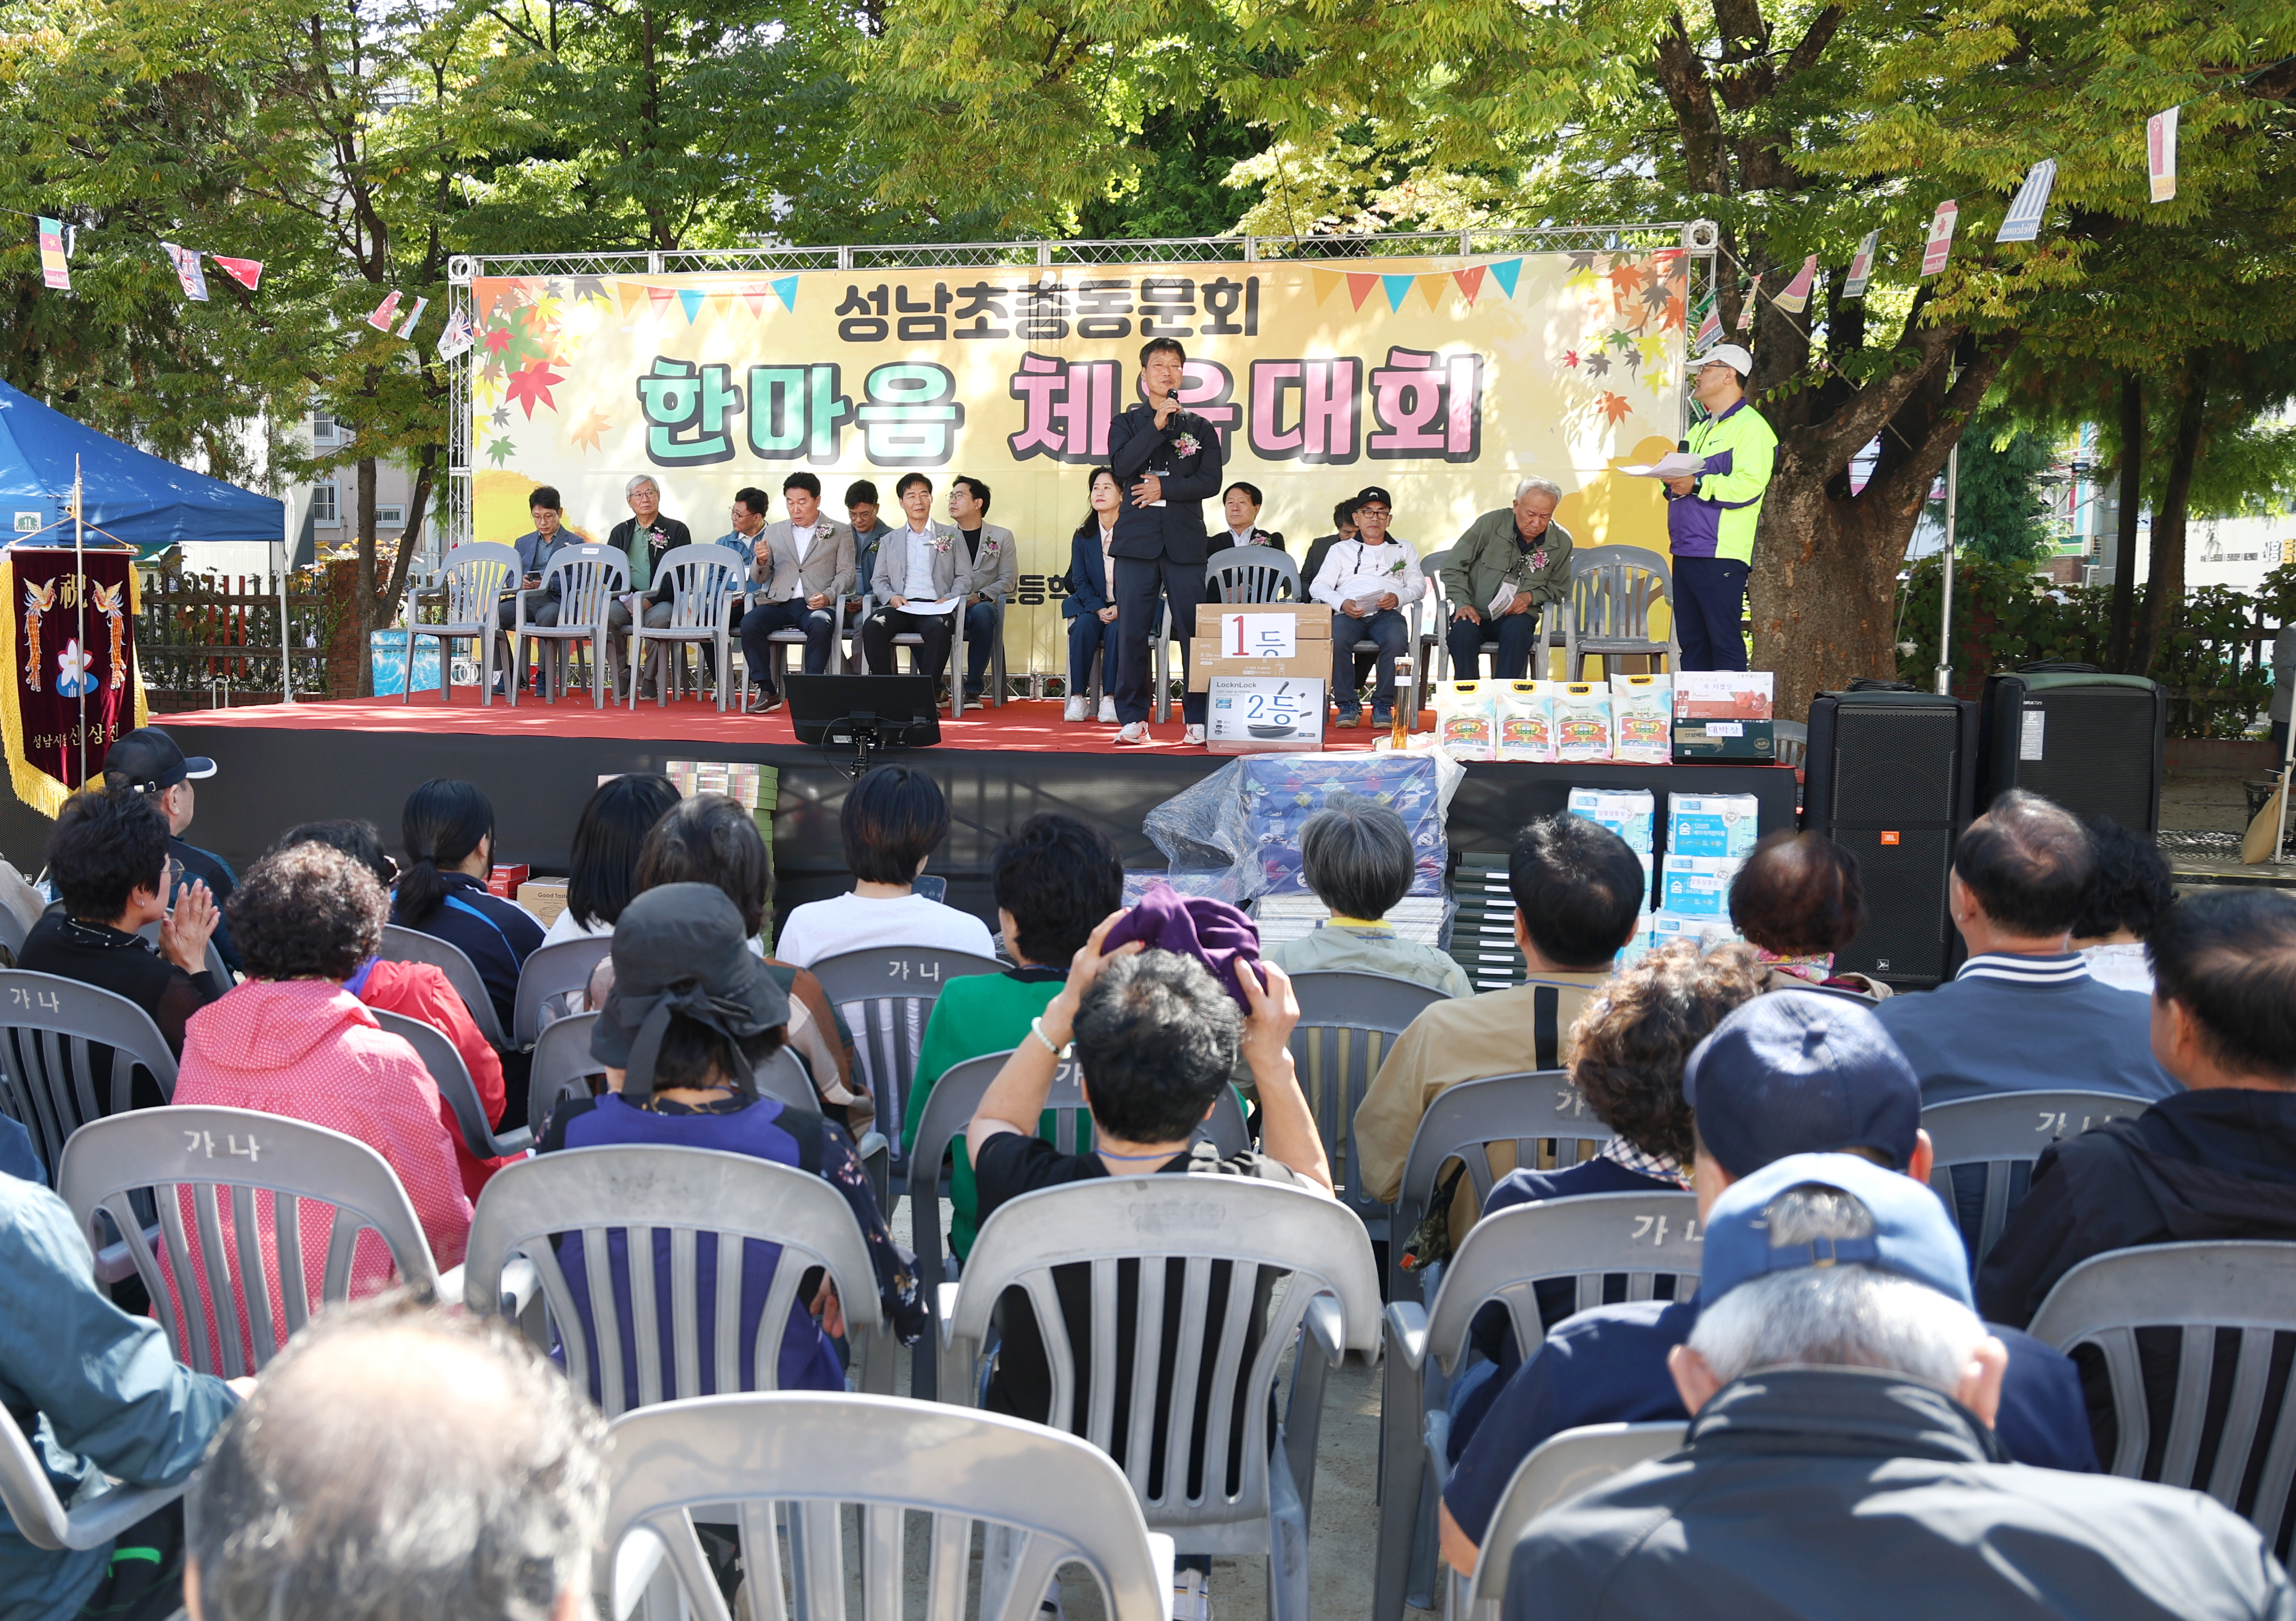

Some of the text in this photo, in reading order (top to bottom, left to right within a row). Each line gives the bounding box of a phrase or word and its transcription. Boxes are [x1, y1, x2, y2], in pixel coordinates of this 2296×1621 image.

[835, 276, 1258, 342] 성남초총동문회
[637, 356, 965, 466] 한마음
[1006, 574, 1071, 605] 등학
[1247, 695, 1299, 725] 2등
[1679, 822, 1691, 836] 숨
[1670, 880, 1683, 894] 숨
